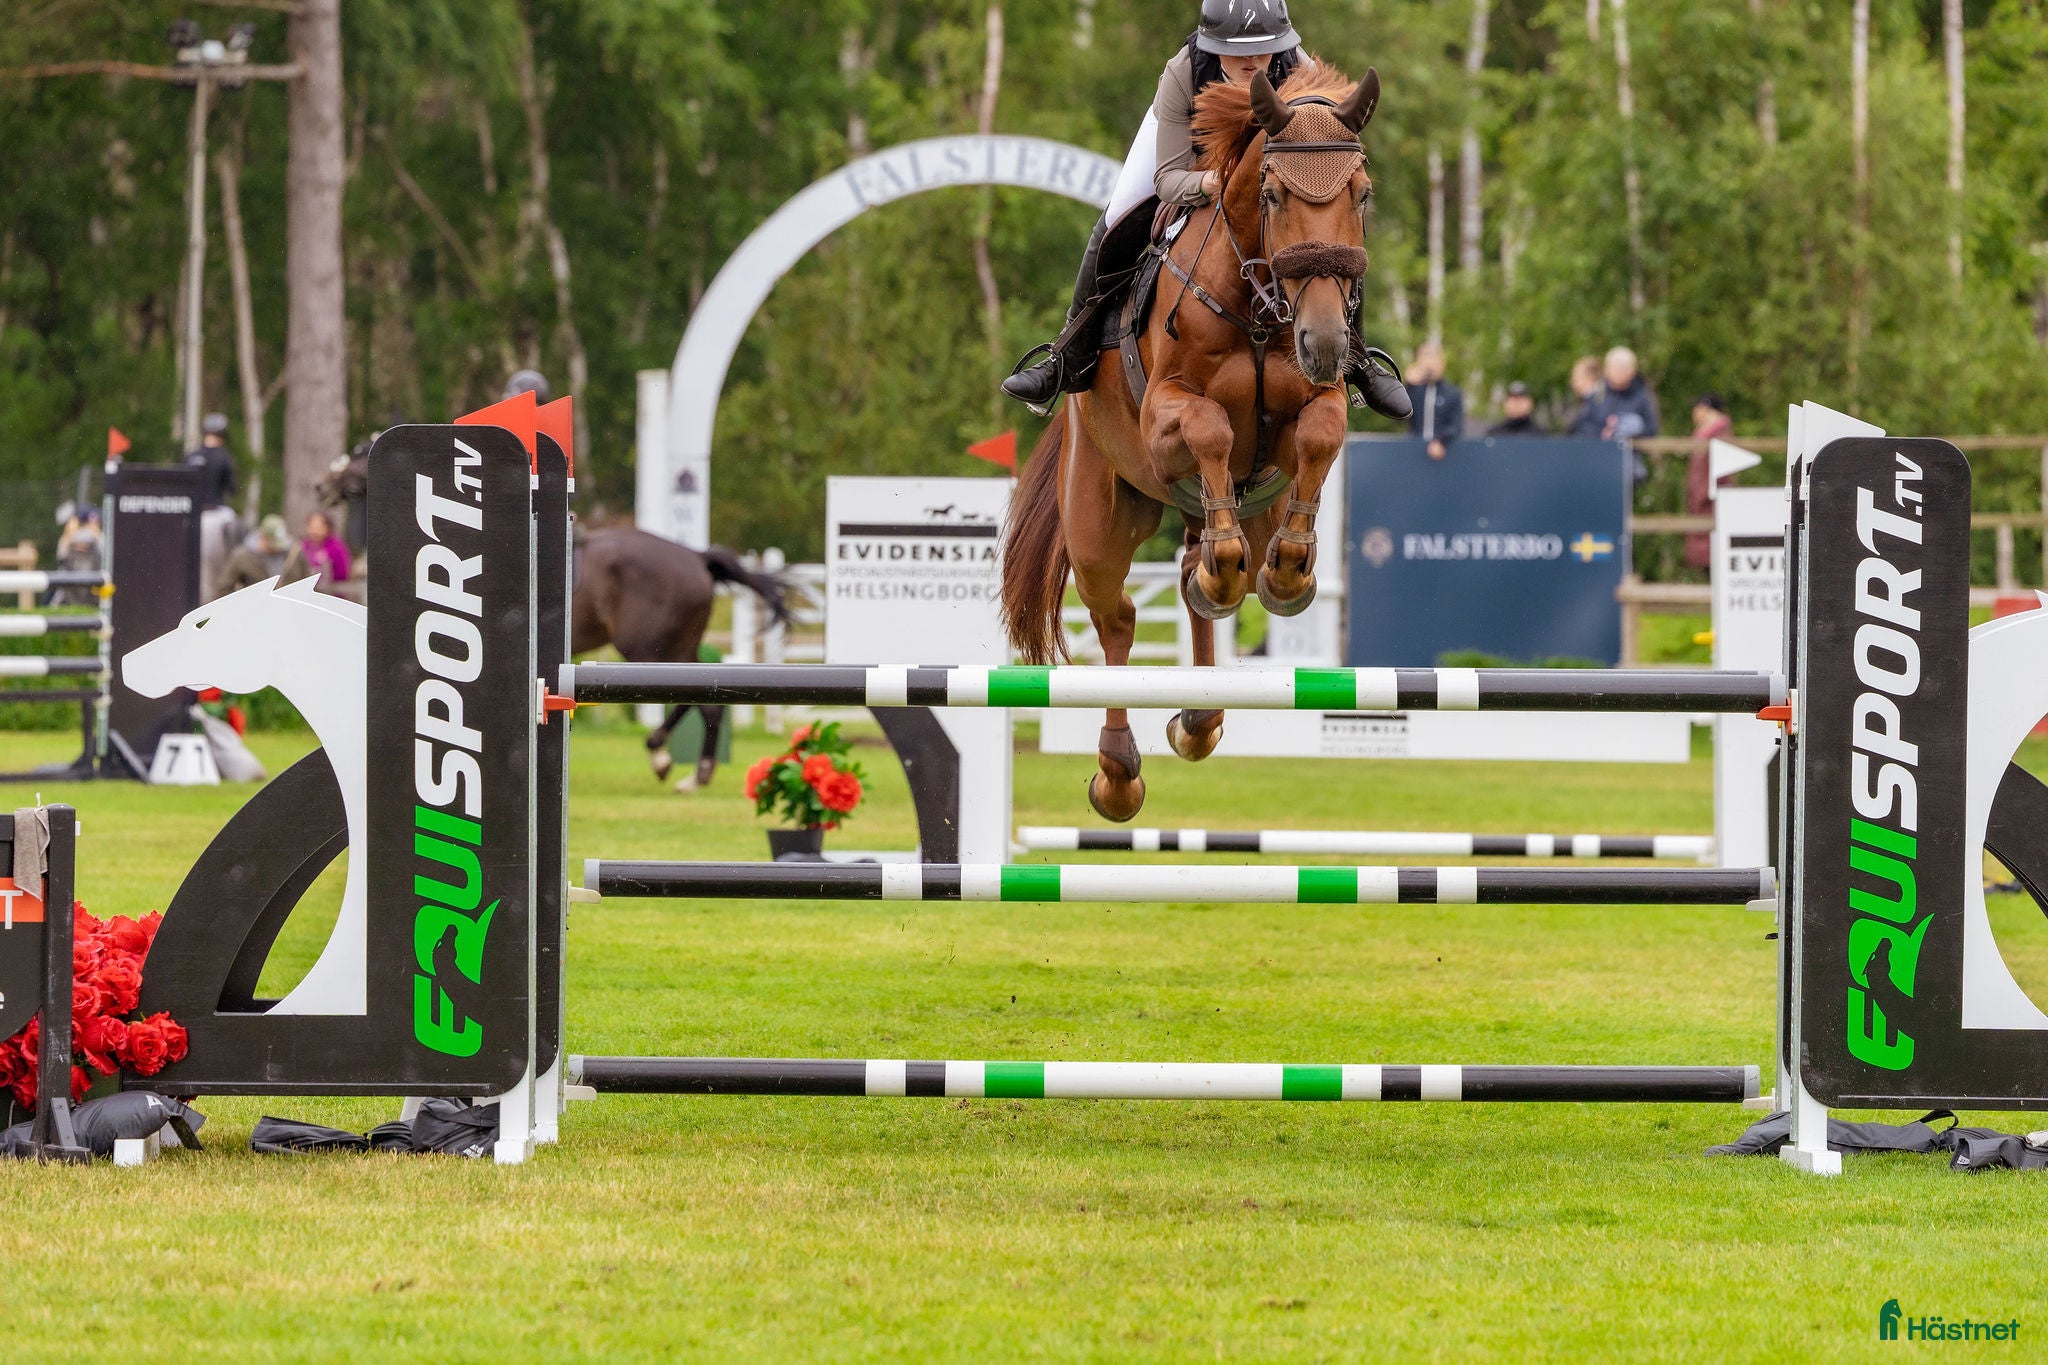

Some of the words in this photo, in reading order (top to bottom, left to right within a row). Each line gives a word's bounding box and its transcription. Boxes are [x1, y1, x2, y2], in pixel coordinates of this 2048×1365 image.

[845, 139, 1114, 207] FALSTERB
[838, 544, 997, 561] EVIDENSIA
[1403, 533, 1563, 560] FALSTERBO
[1729, 555, 1784, 572] EVI
